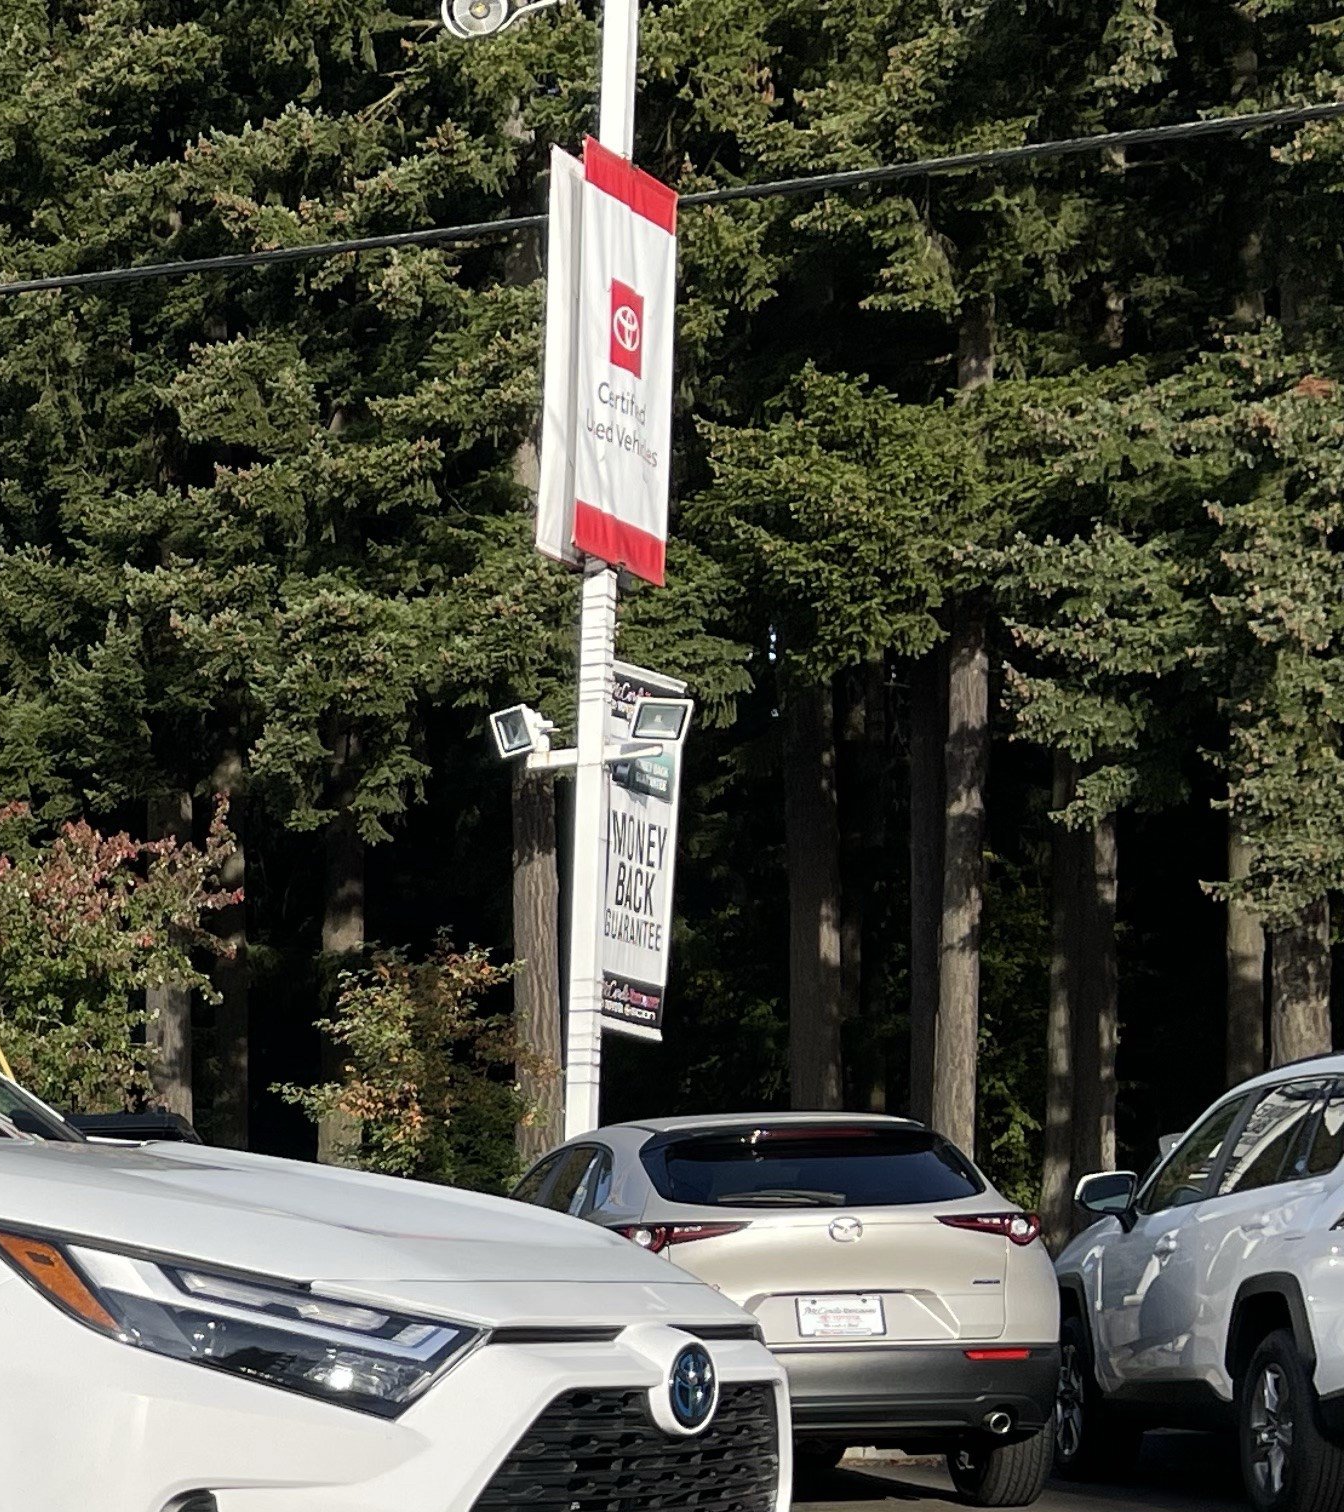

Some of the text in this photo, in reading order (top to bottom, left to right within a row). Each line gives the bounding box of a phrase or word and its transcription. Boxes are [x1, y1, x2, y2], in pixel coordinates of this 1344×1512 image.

[586, 407, 614, 443] Ued
[612, 809, 668, 870] MONEY
[615, 861, 656, 917] BACK
[604, 908, 662, 952] GUARANTEE
